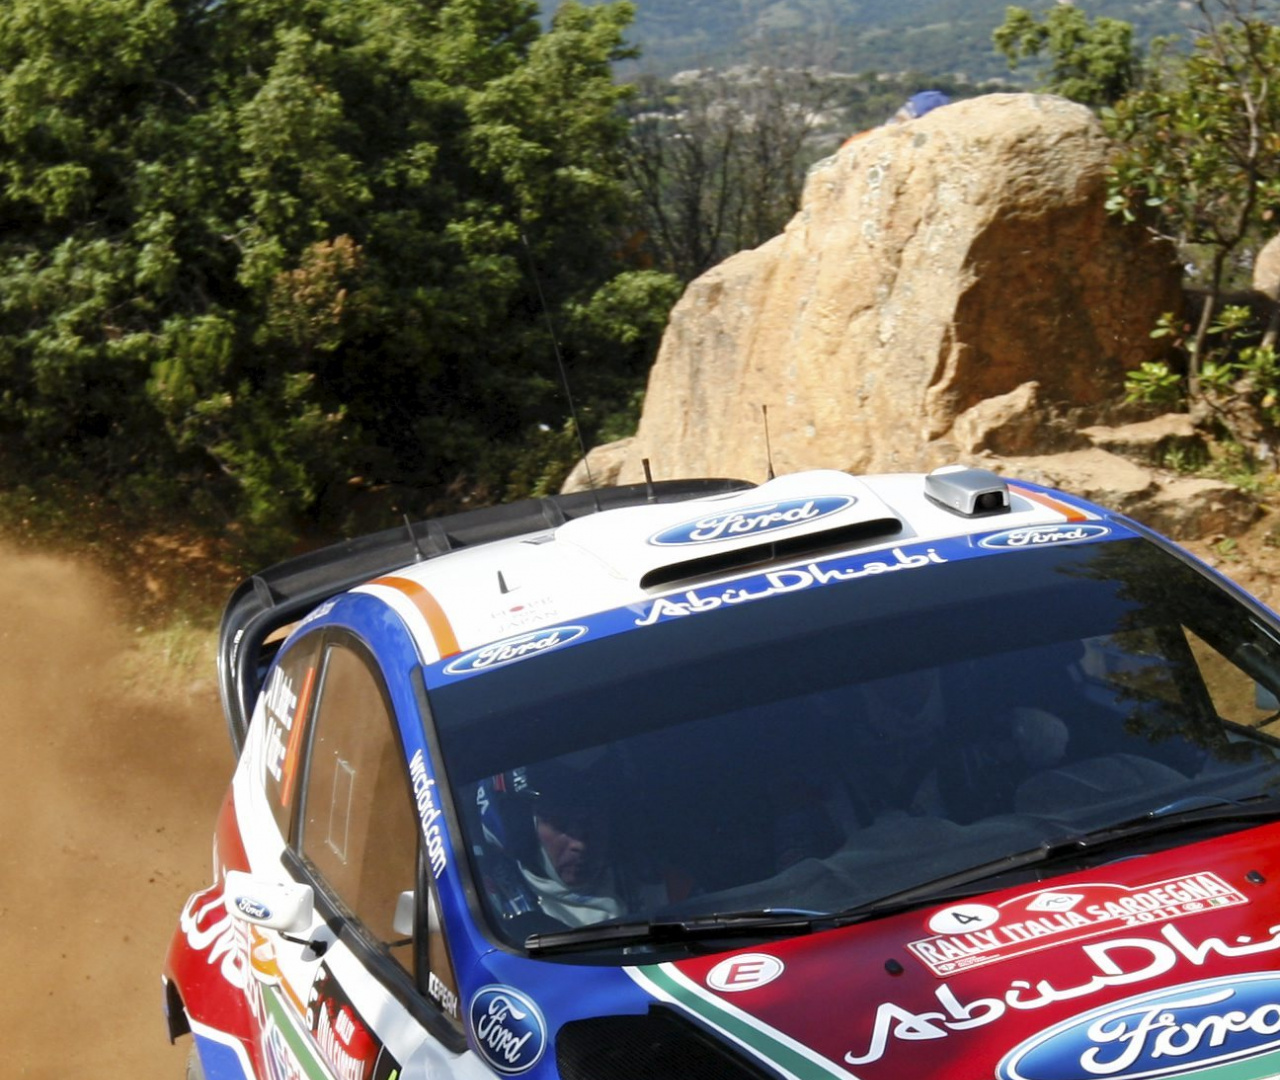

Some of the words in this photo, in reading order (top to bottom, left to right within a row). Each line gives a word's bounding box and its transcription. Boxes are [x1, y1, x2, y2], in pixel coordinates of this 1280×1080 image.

[689, 500, 819, 540] Ford
[1007, 525, 1093, 546] Ford
[472, 631, 560, 668] Ford
[409, 749, 447, 879] wrcford.com
[239, 900, 266, 917] Ford
[916, 928, 1002, 964] RALLY
[1000, 912, 1082, 945] ITALIA
[1086, 875, 1231, 921] SARDEGNA
[951, 911, 982, 926] 4
[1120, 906, 1182, 926] 2011
[725, 959, 764, 985] E
[478, 995, 532, 1063] Ford
